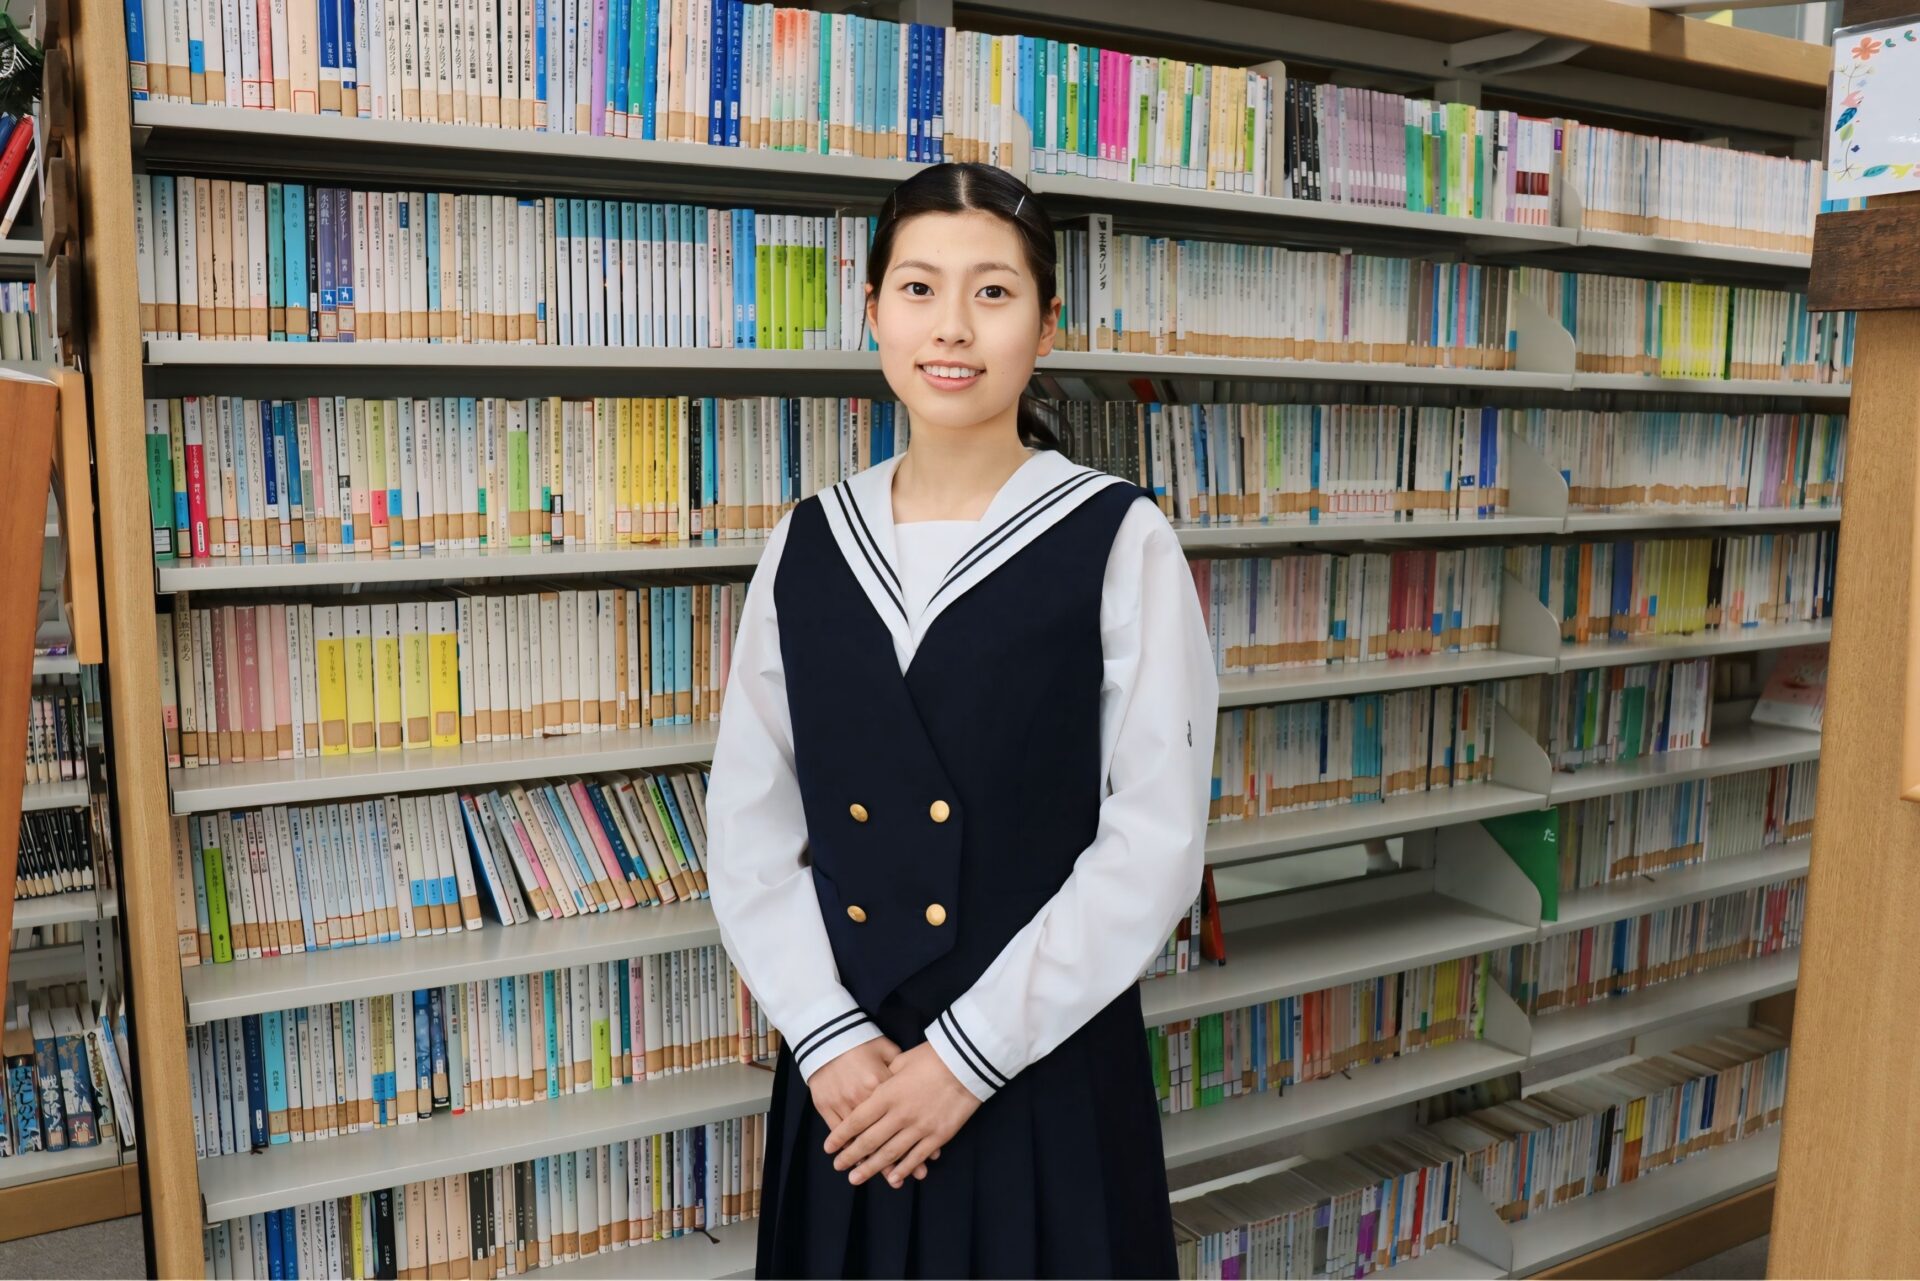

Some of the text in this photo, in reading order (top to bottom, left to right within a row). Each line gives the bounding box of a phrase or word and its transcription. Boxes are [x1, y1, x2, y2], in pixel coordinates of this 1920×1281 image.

[1544, 828, 1556, 842] た
[15, 1068, 36, 1140] はだしのゲン
